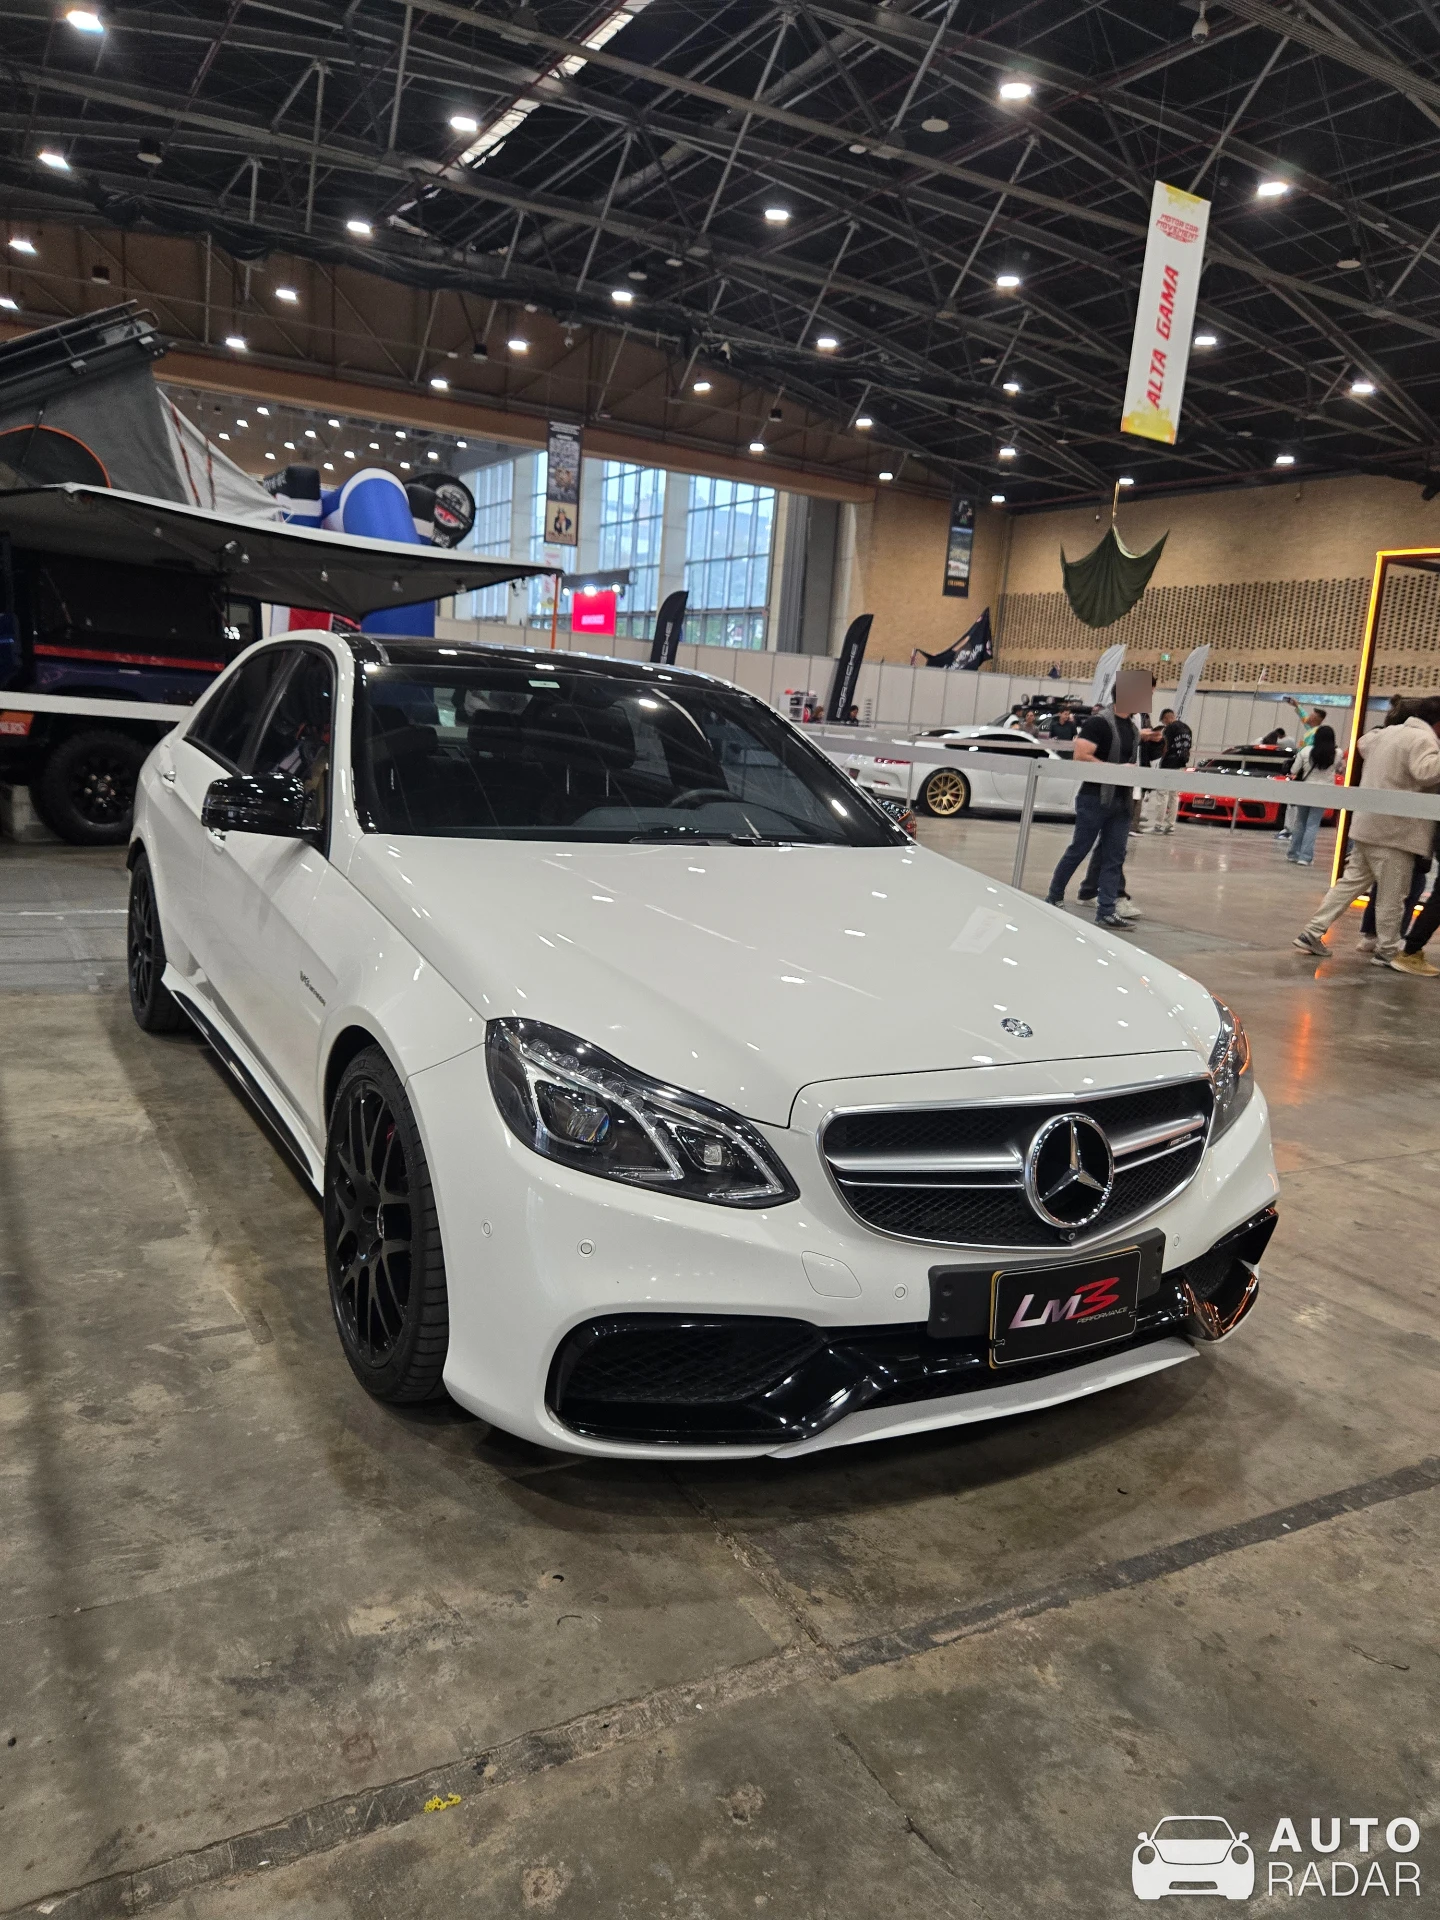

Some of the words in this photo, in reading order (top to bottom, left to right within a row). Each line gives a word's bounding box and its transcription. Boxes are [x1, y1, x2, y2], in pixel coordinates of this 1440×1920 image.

[1156, 219, 1199, 240] MOVEMENT
[1160, 213, 1184, 228] MOTOR
[1156, 265, 1180, 341] GAMA
[1146, 348, 1168, 411] ALTA
[660, 622, 674, 664] SCHE
[836, 643, 859, 719] PORSCHE
[1008, 1276, 1120, 1329] LM3
[1076, 1306, 1128, 1325] PERFORMANCE
